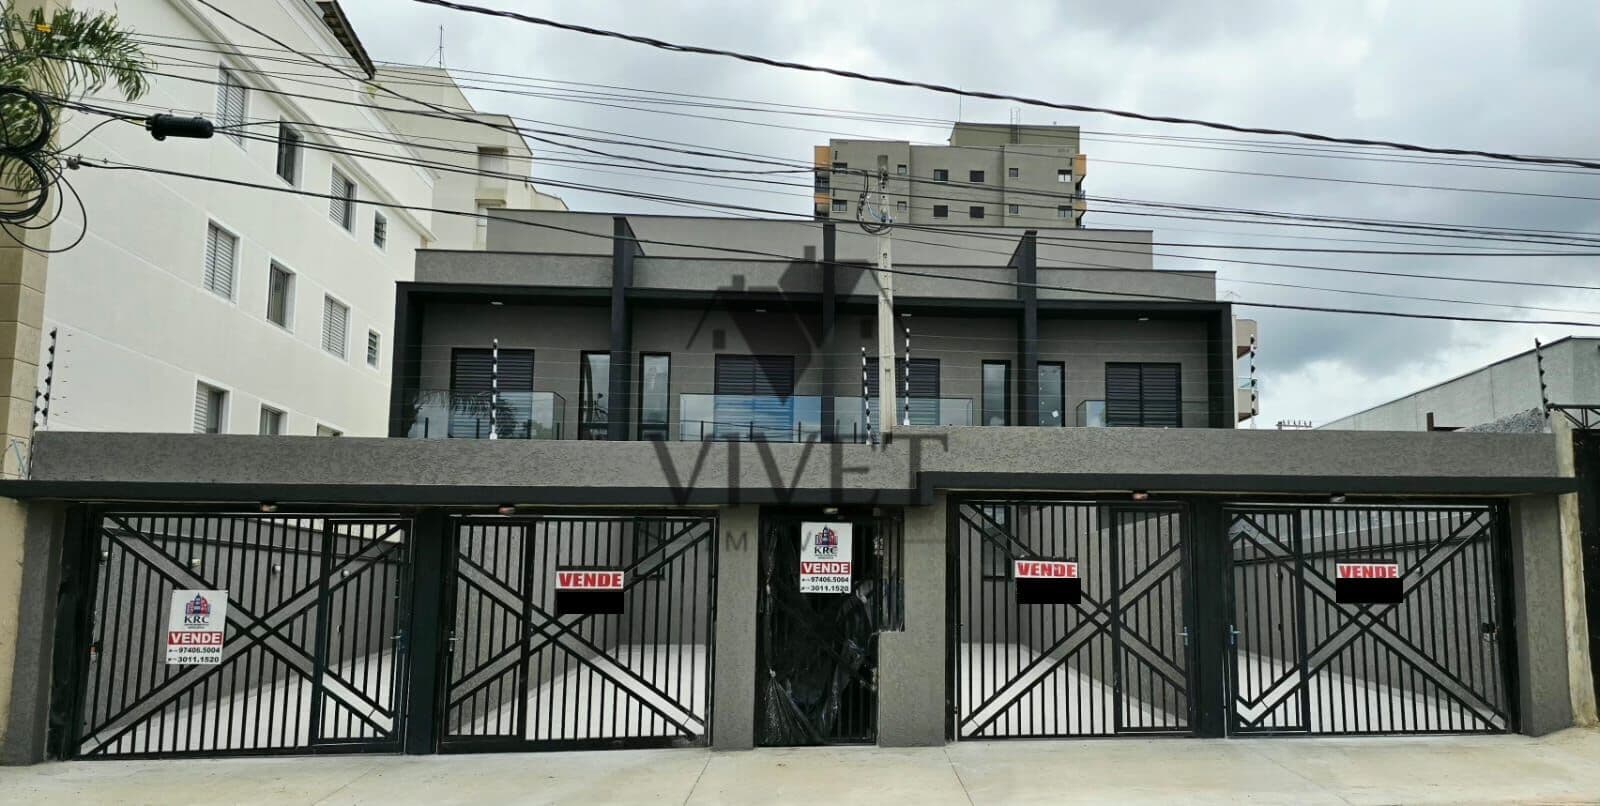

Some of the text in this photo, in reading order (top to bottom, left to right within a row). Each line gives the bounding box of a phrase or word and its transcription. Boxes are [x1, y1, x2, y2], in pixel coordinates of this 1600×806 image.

[814, 546, 838, 554] KRC
[803, 563, 849, 573] VENDE
[1017, 562, 1077, 577] VENDE
[1339, 565, 1397, 578] VENDE
[559, 573, 622, 587] VENDE
[184, 615, 209, 623] KRC
[171, 632, 220, 644] VENDE
